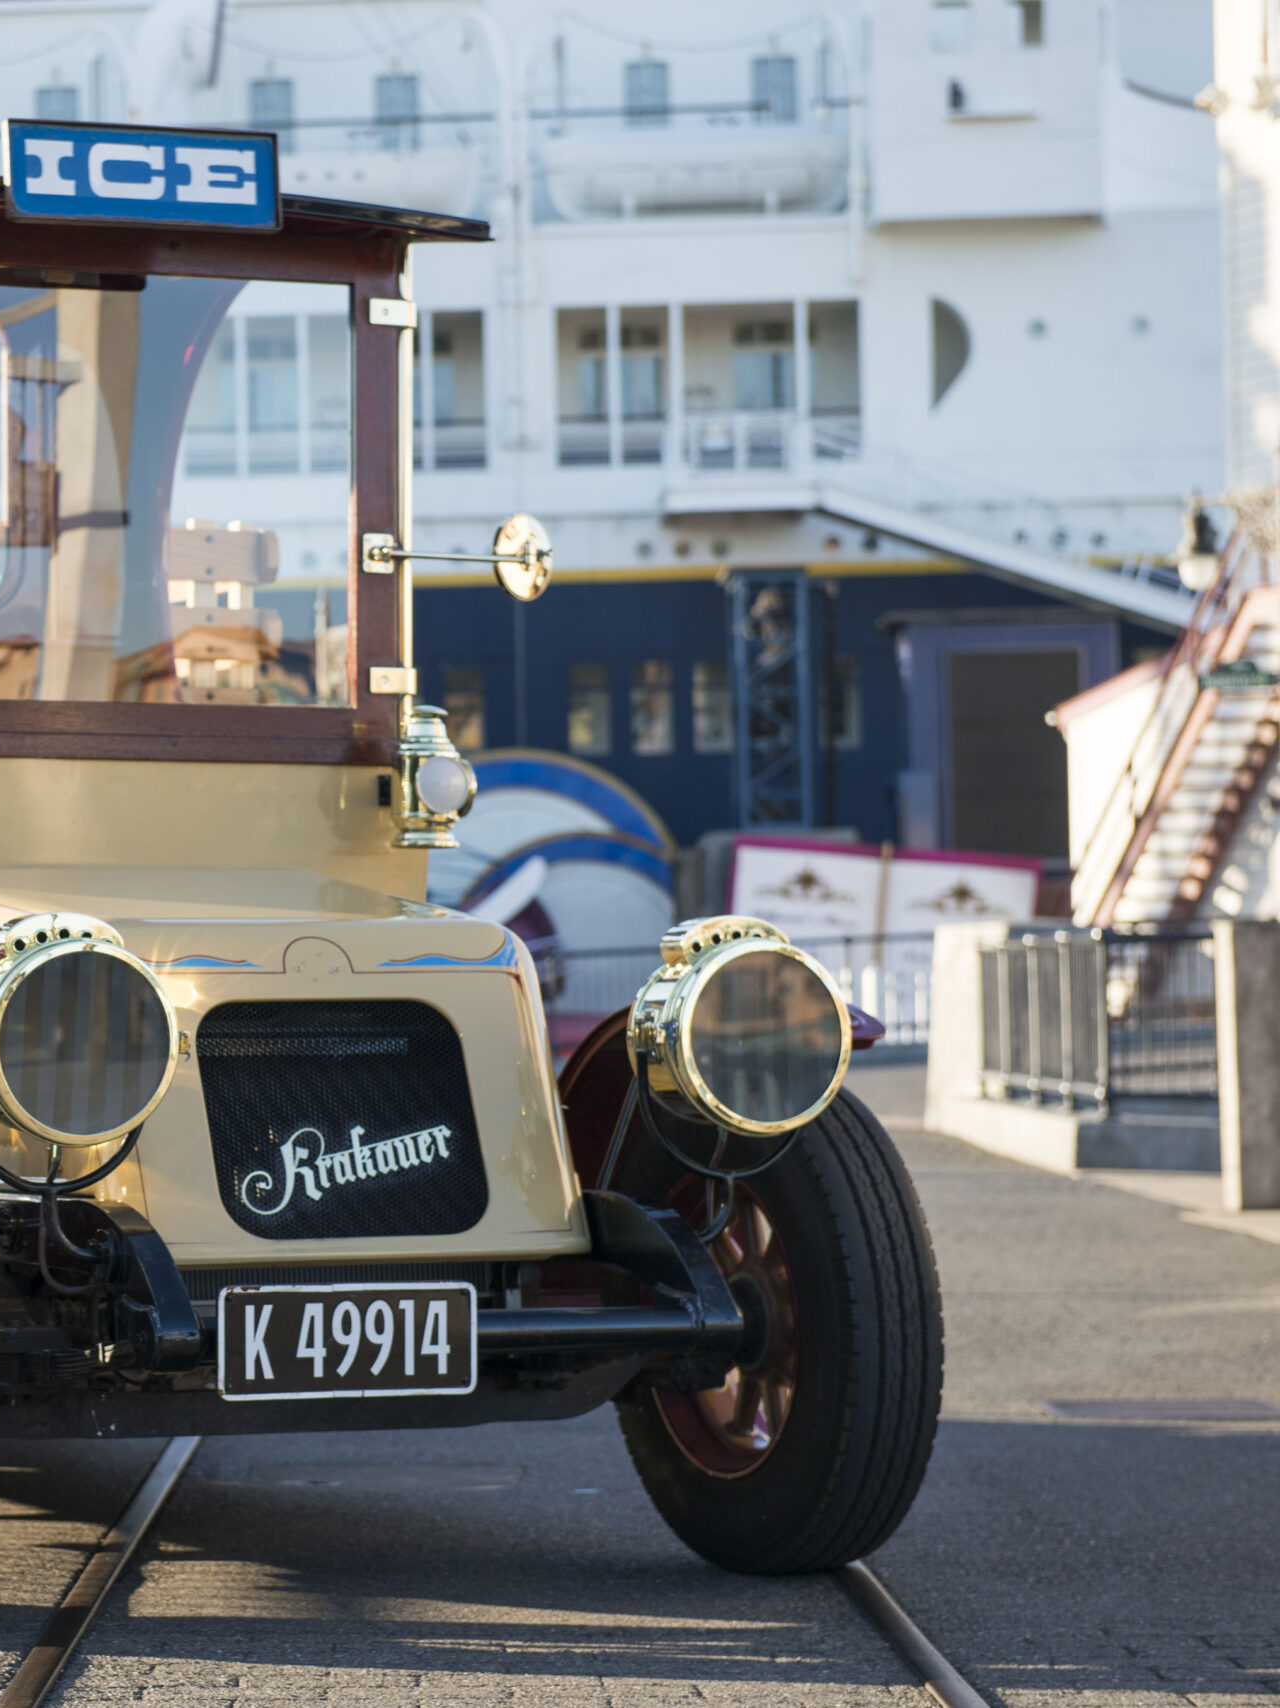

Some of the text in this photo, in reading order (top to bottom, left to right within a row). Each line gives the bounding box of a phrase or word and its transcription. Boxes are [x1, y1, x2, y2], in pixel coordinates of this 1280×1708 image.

[24, 138, 257, 205] ICE
[242, 1124, 452, 1215] Krakauer
[244, 1300, 451, 1381] K 49914
